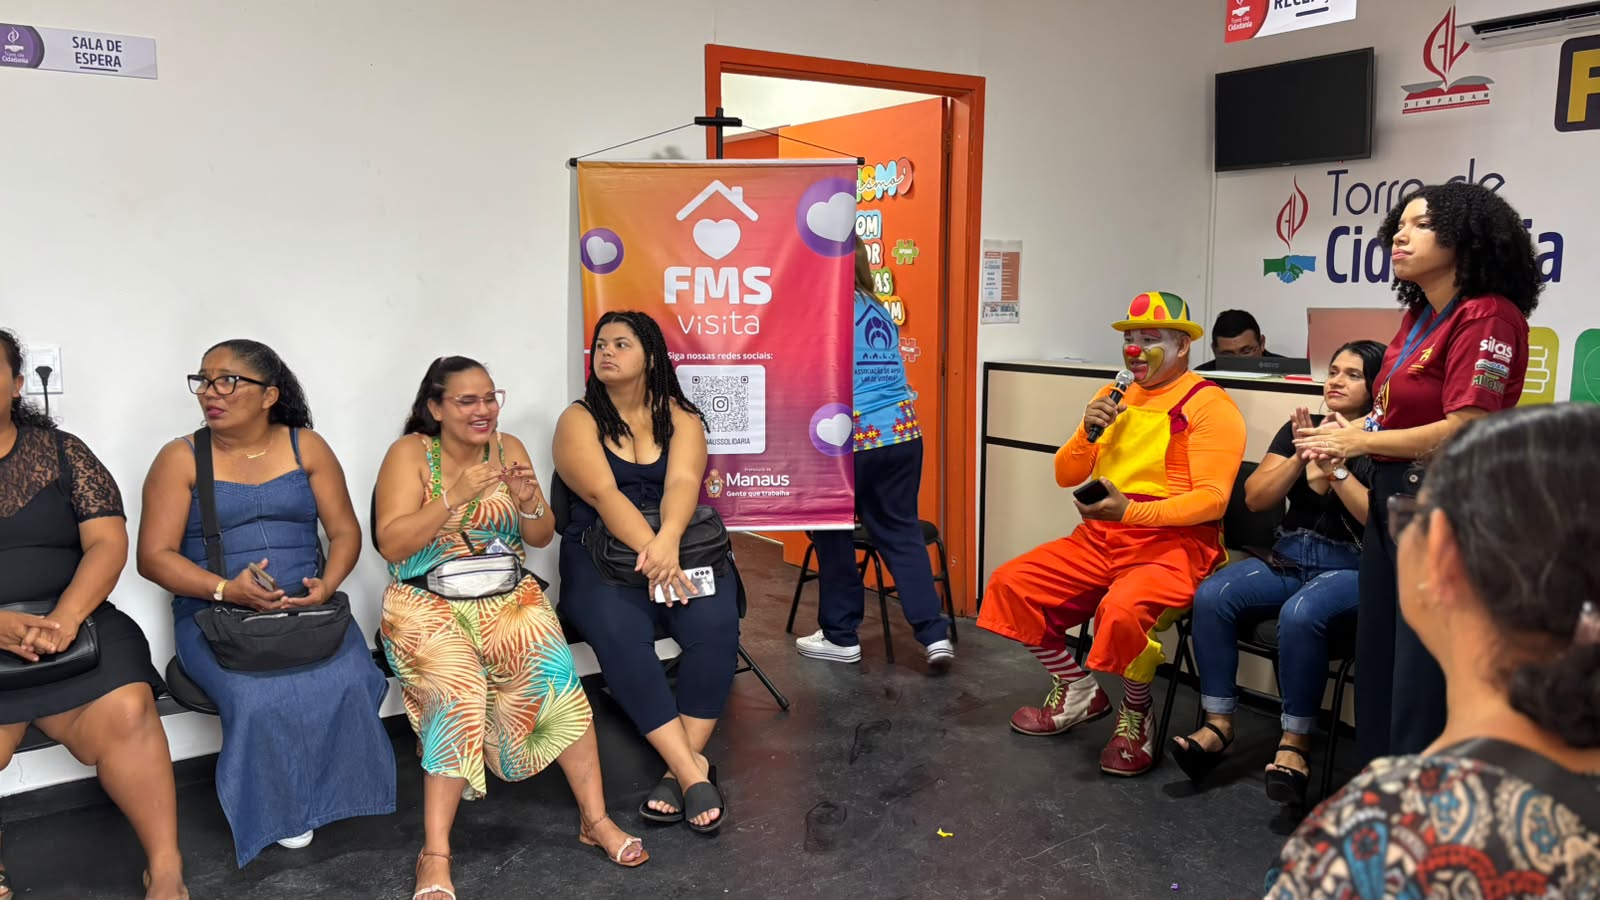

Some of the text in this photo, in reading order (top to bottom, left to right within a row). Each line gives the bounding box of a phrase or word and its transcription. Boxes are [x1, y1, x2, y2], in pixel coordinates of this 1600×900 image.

[1228, 21, 1253, 31] Cidadania
[72, 36, 122, 53] SALA DE
[75, 52, 122, 68] ESPERA
[855, 215, 880, 237] OM
[663, 266, 773, 304] FMS
[677, 311, 761, 335] visita
[1479, 336, 1512, 358] silas
[667, 351, 685, 361] Siga
[718, 352, 741, 360] redes
[743, 352, 773, 360] sociais:
[726, 472, 790, 487] Manaus
